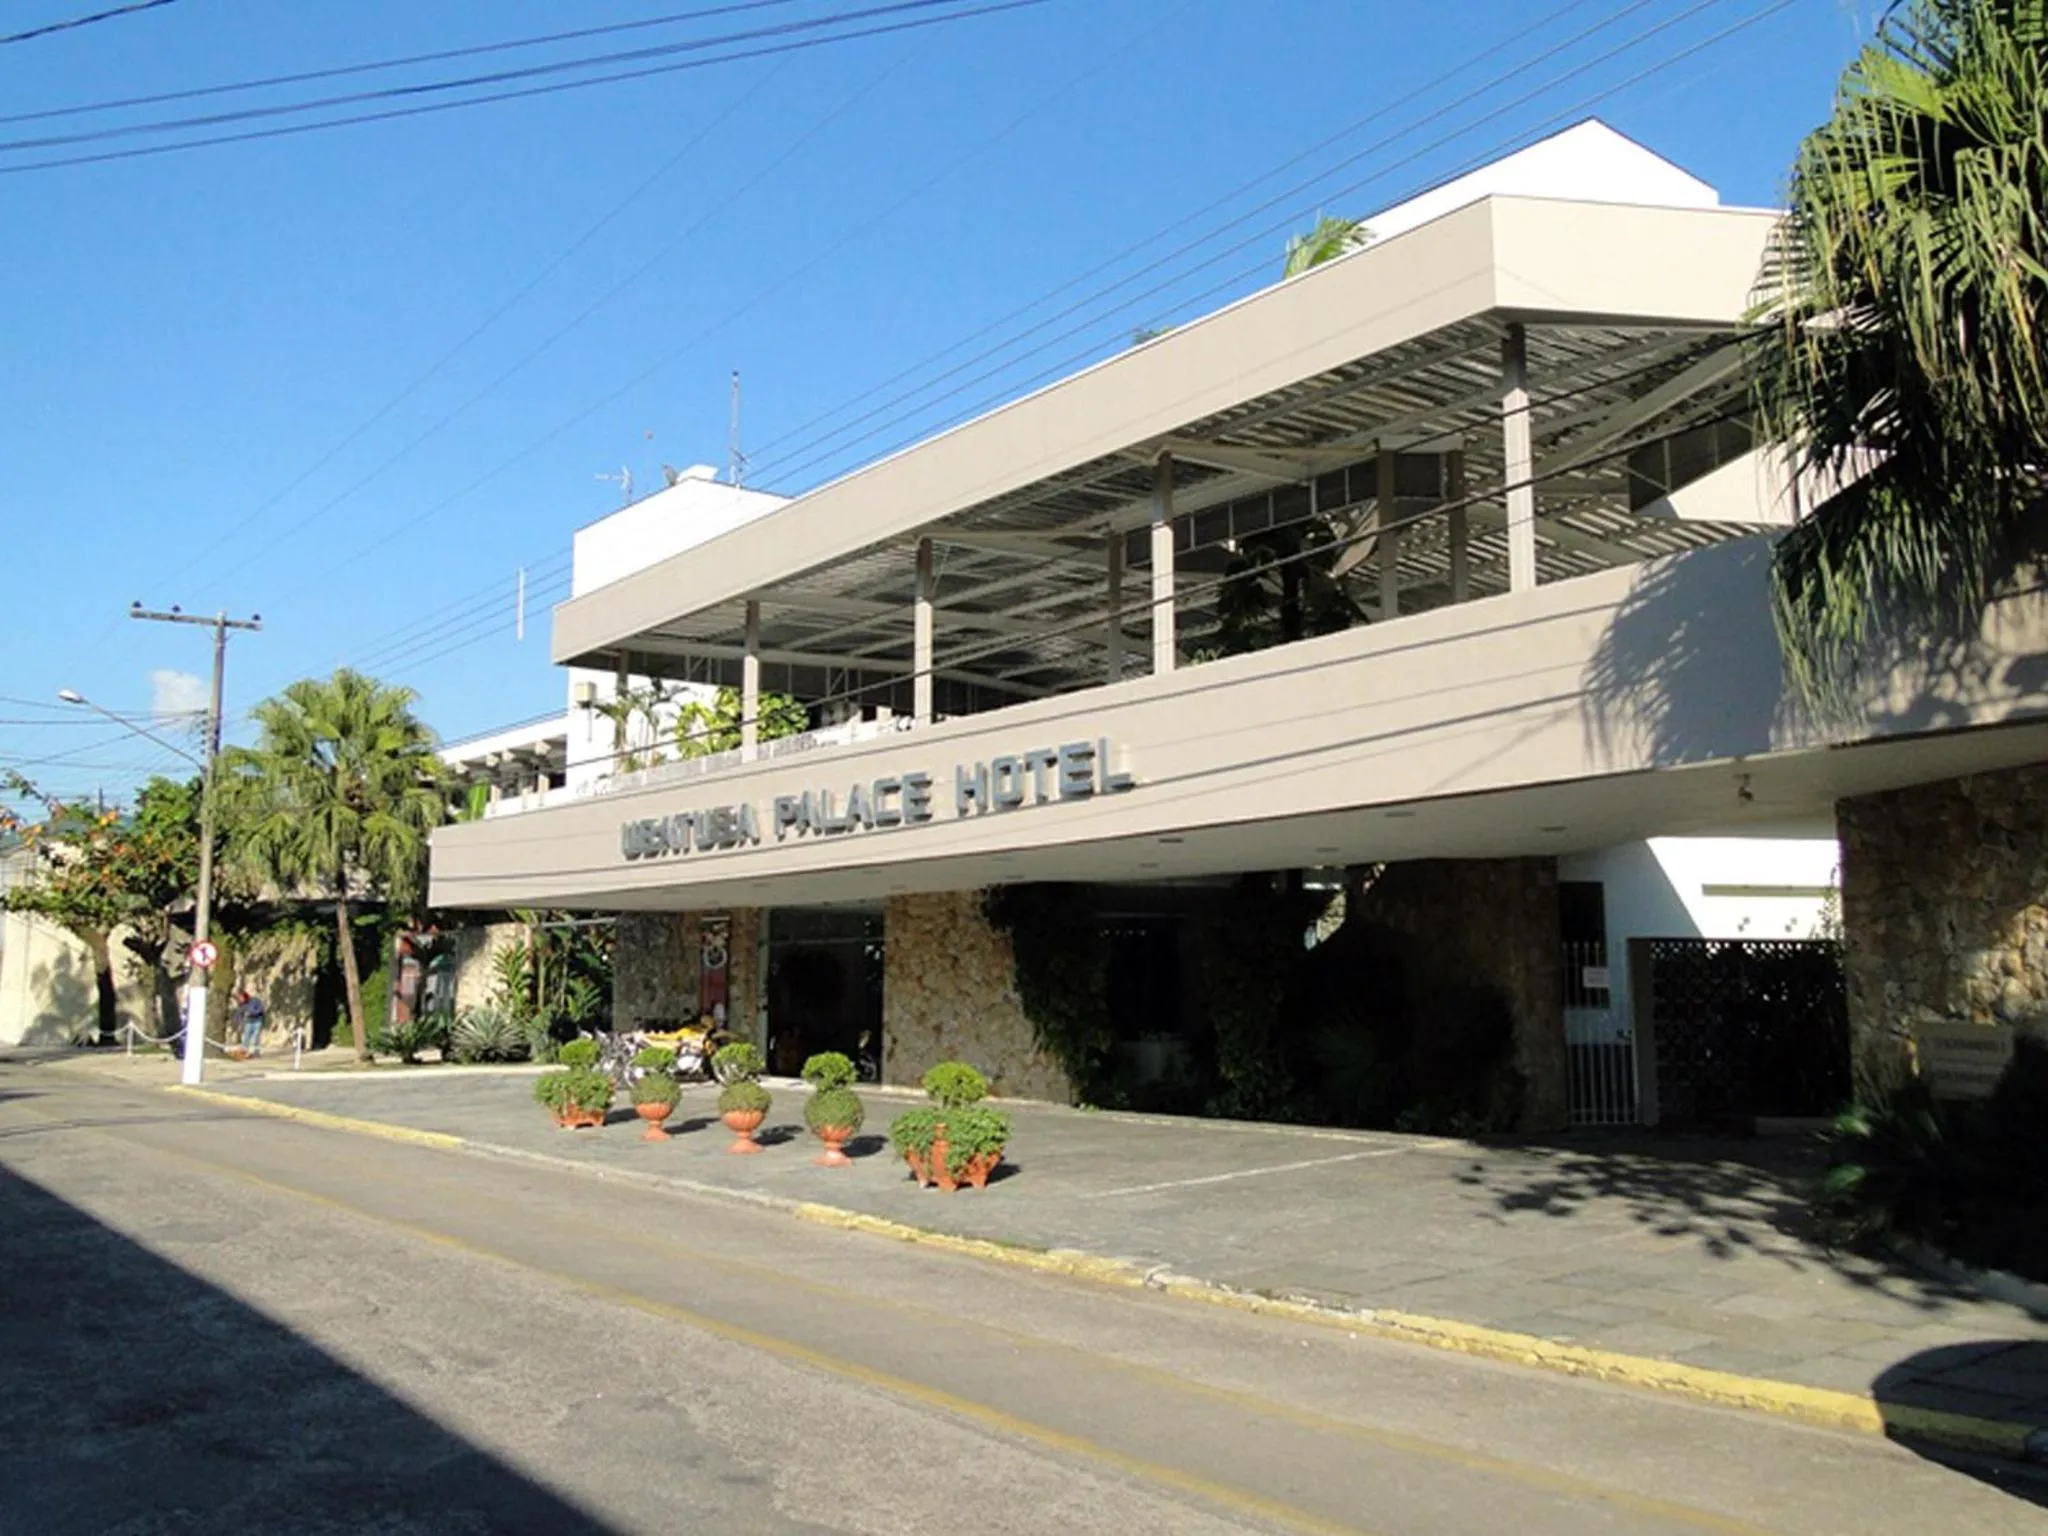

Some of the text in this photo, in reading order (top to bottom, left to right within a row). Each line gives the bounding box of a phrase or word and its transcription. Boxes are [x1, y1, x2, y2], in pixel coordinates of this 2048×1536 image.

[621, 738, 1135, 860] UBATUBA PALACE HOTEL
